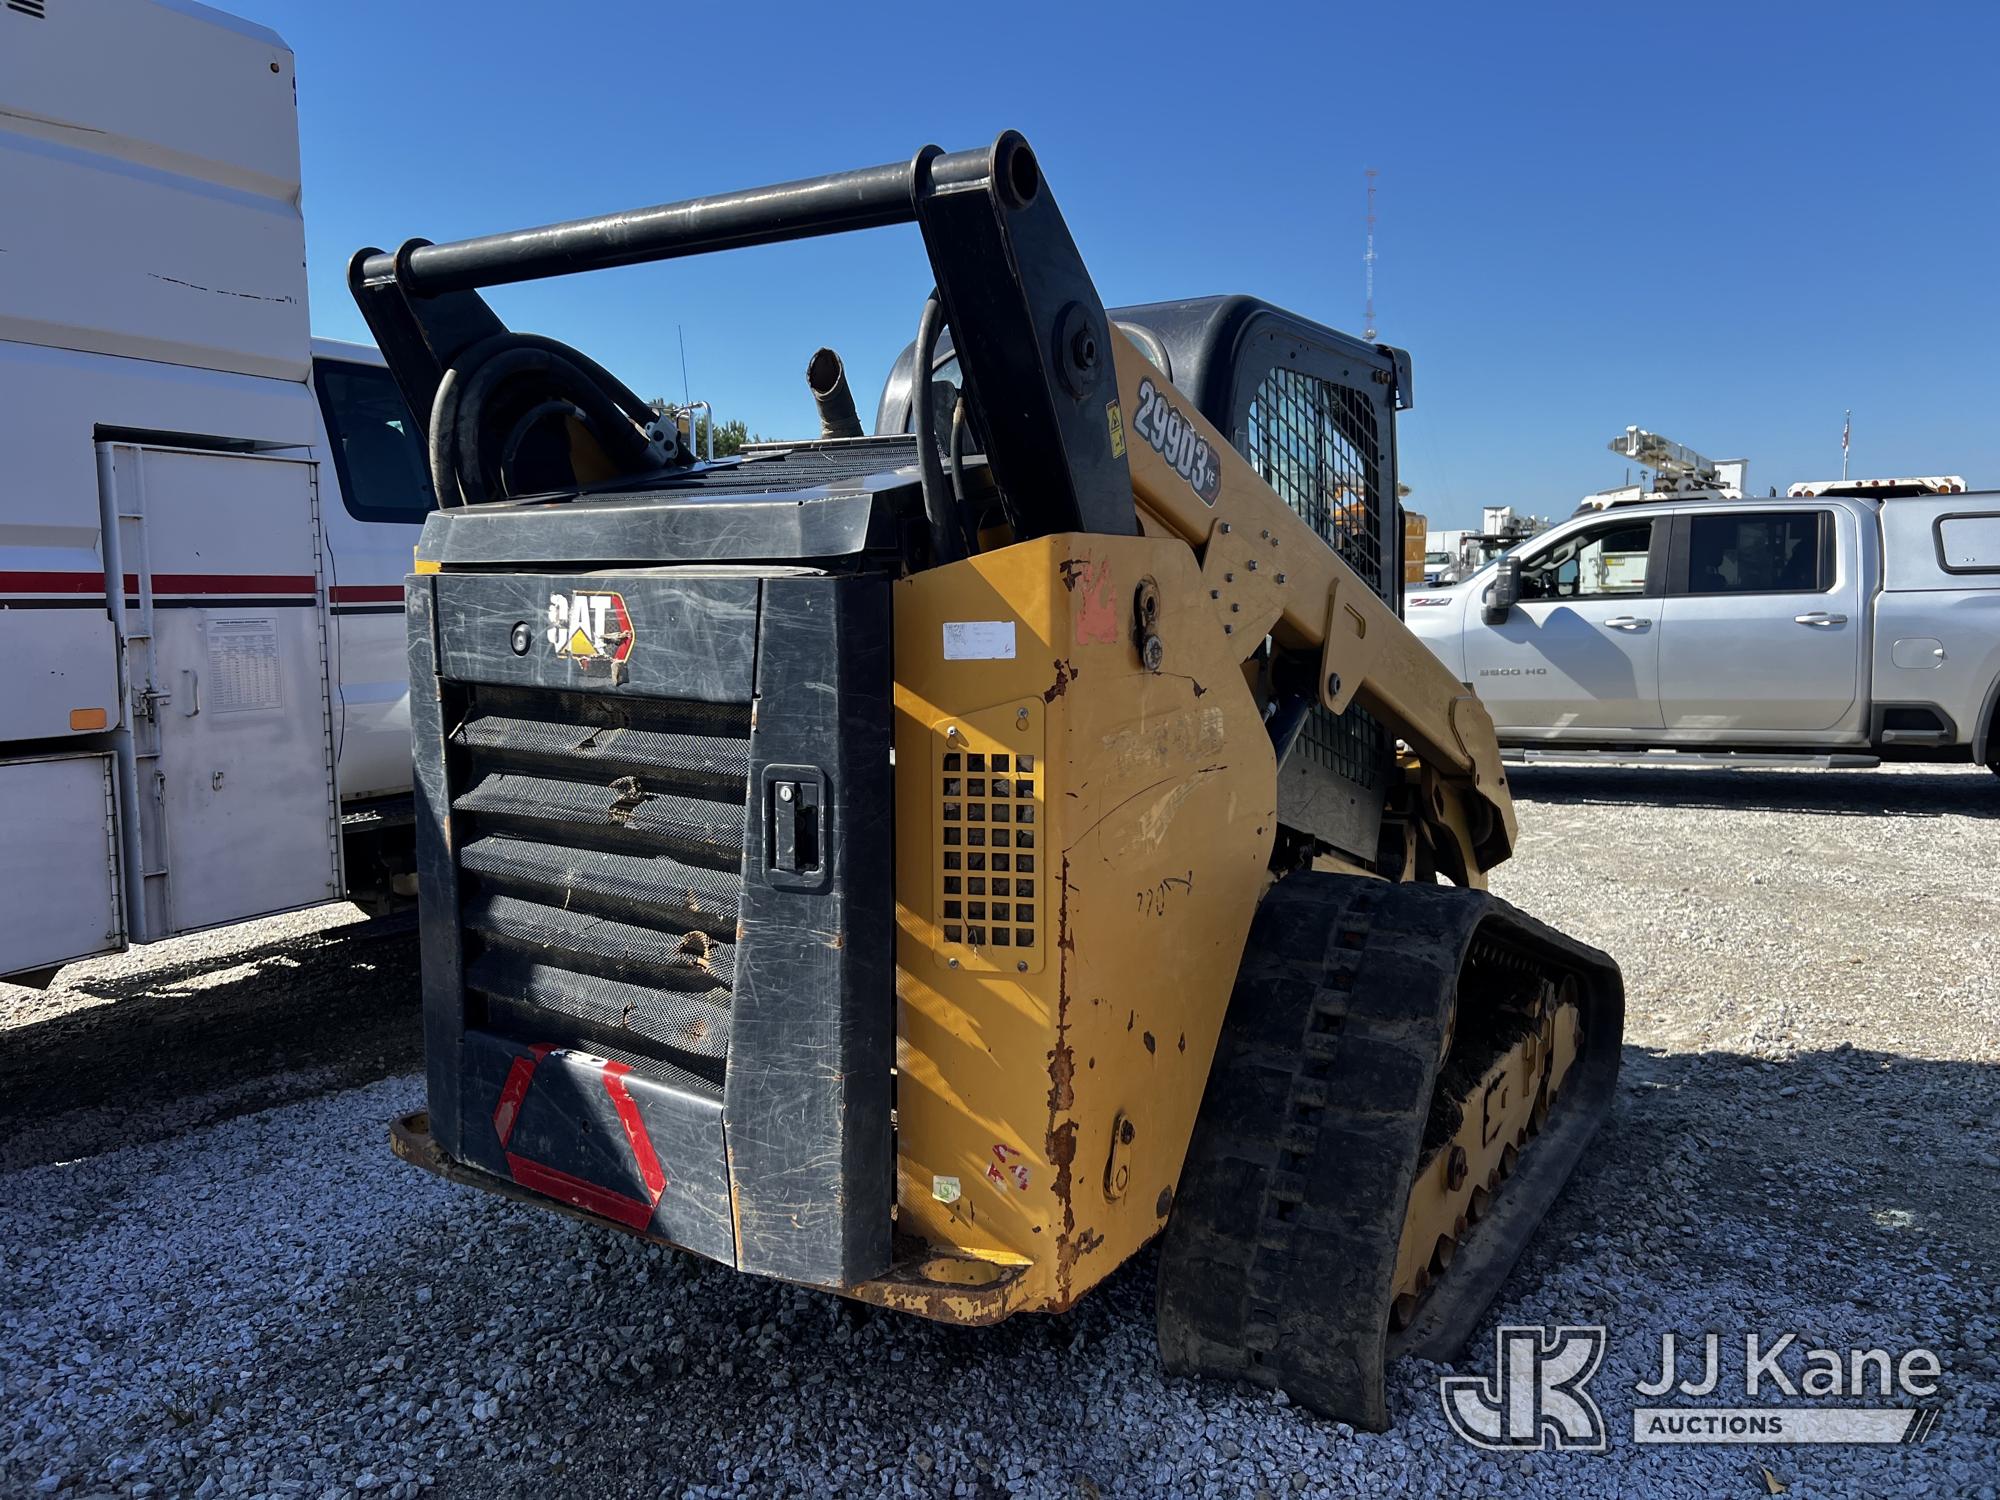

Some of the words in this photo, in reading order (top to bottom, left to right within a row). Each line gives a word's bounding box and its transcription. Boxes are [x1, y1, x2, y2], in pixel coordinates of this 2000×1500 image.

[1135, 380, 1208, 491] 299D3
[547, 593, 612, 657] CAT
[1525, 667, 1547, 676] HD
